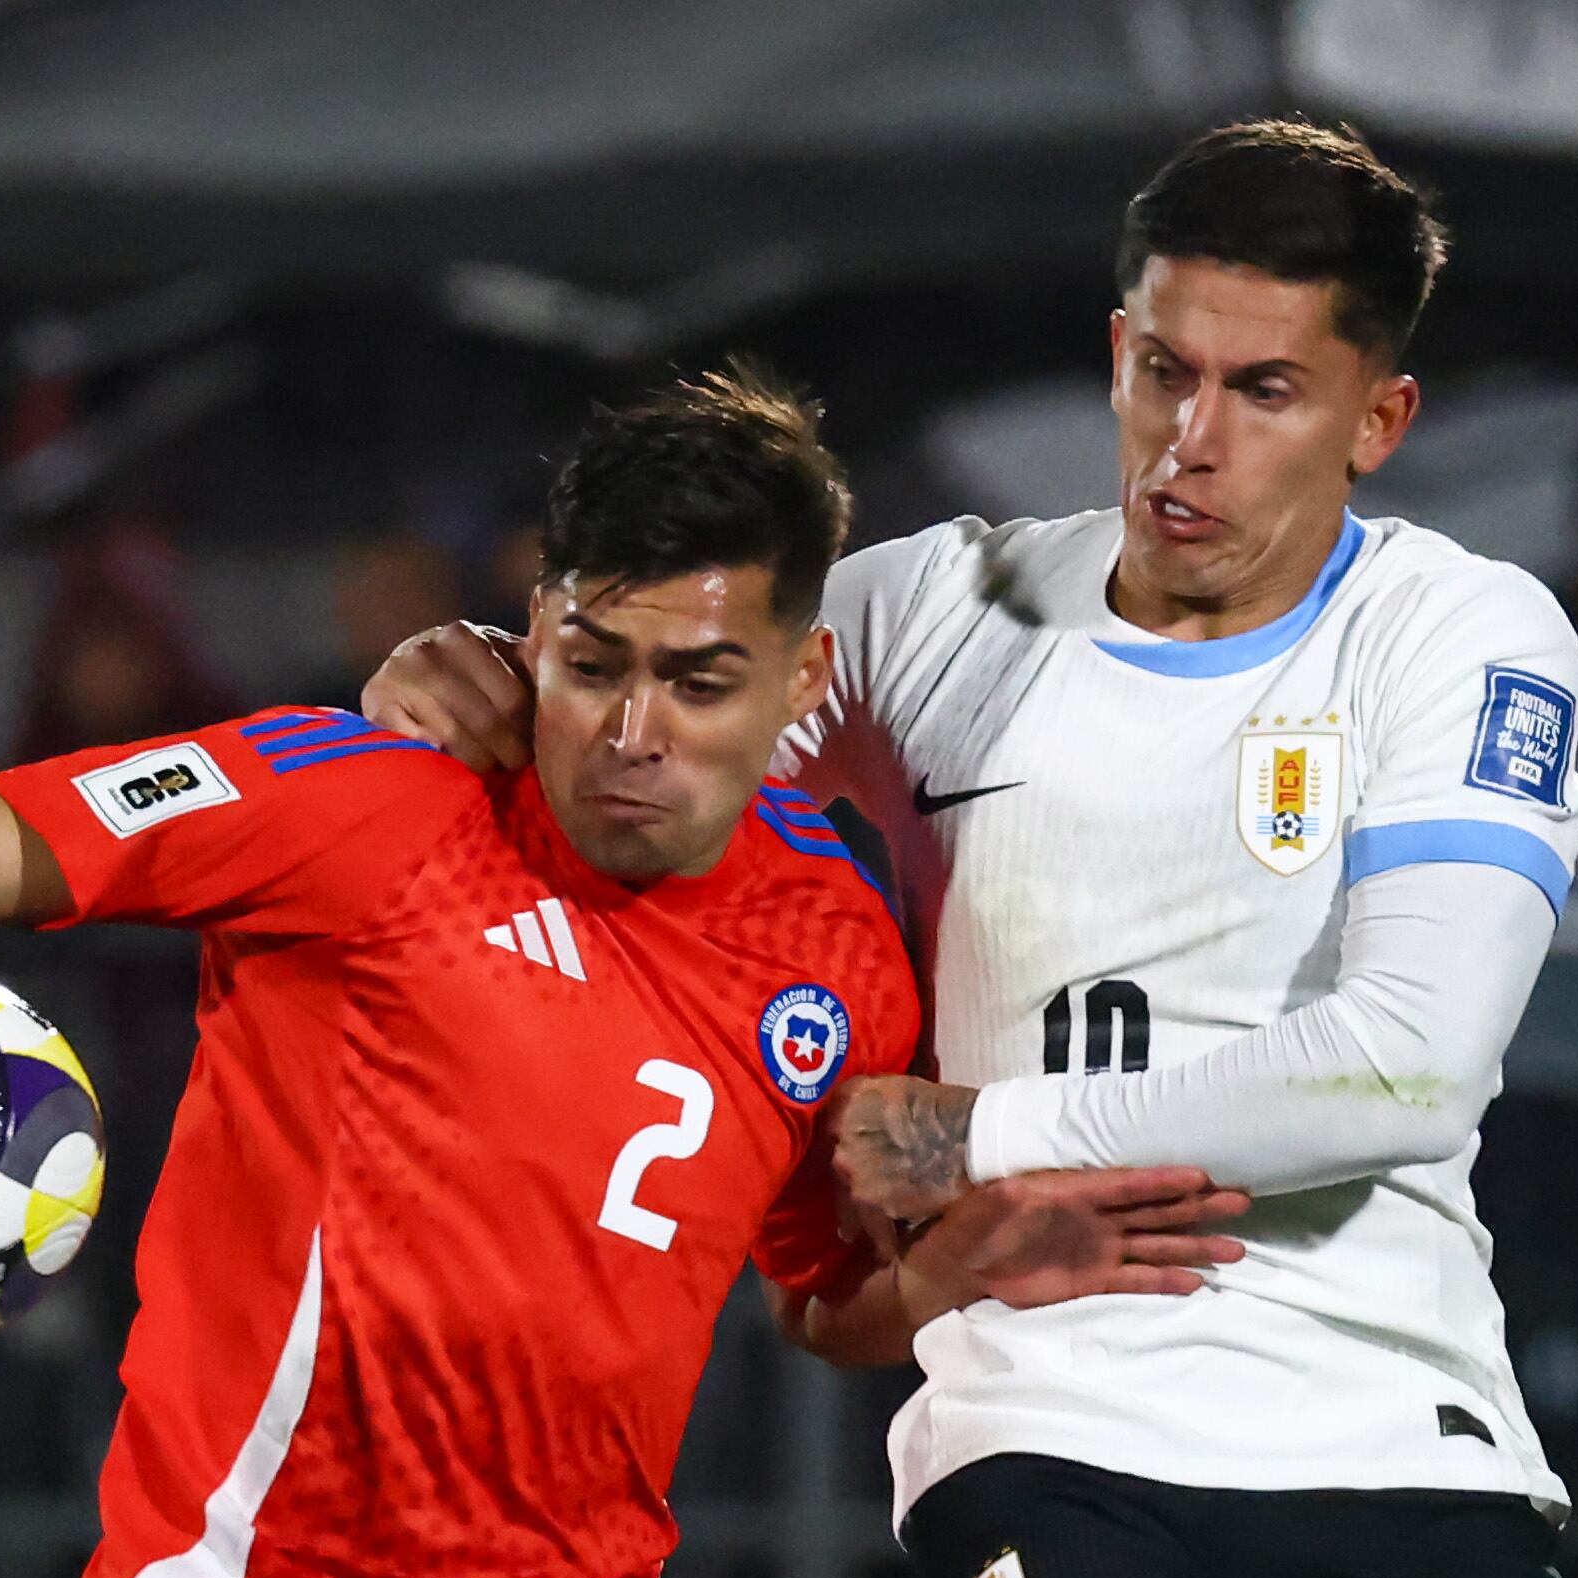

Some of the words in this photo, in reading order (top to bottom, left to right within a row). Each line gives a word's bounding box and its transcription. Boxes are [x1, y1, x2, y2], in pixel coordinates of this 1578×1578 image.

[1511, 688, 1562, 725] FOOTBALL
[1497, 730, 1521, 750] the
[1504, 705, 1561, 747] UNITES
[1514, 761, 1537, 777] FIFA
[597, 1058, 715, 1253] 2
